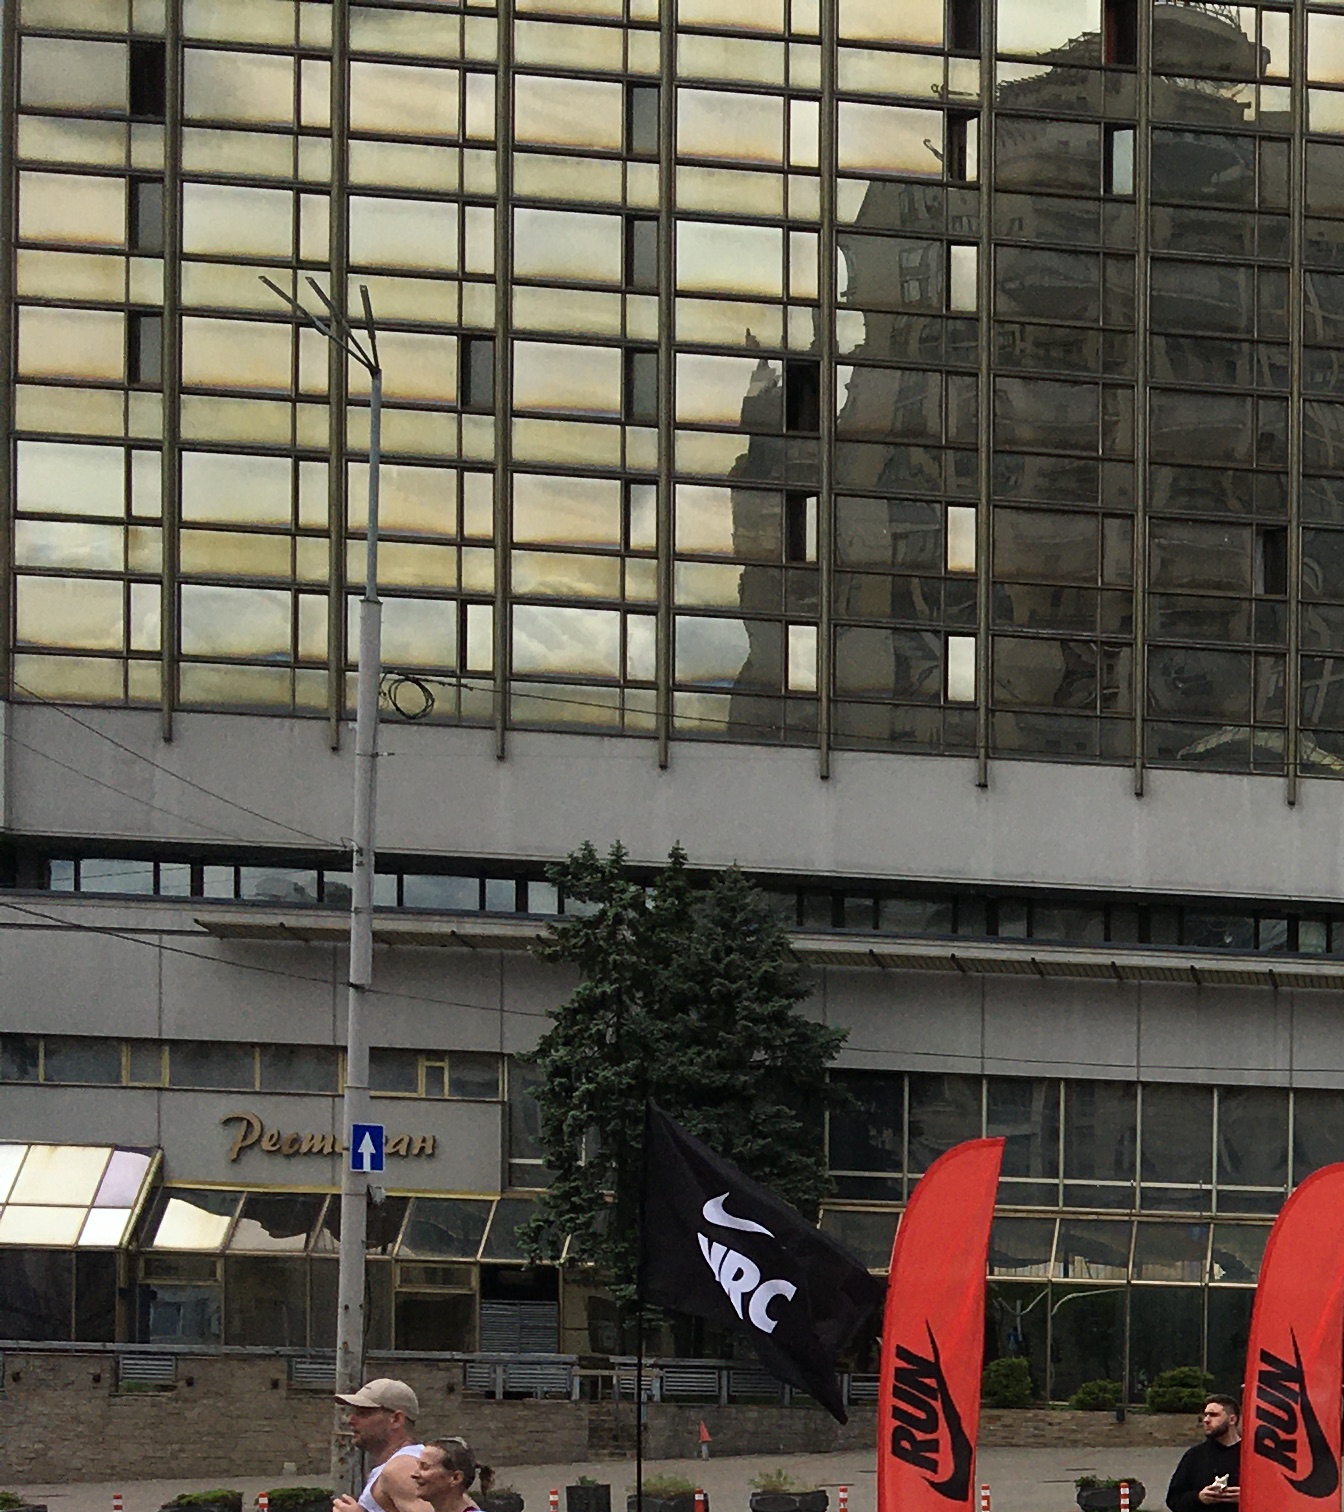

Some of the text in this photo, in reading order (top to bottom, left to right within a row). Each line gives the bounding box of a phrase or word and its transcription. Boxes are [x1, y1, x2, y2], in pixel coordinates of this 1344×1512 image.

[219, 1112, 437, 1162] Рестан
[891, 1343, 941, 1475] RUN
[1254, 1348, 1302, 1473] RUN
